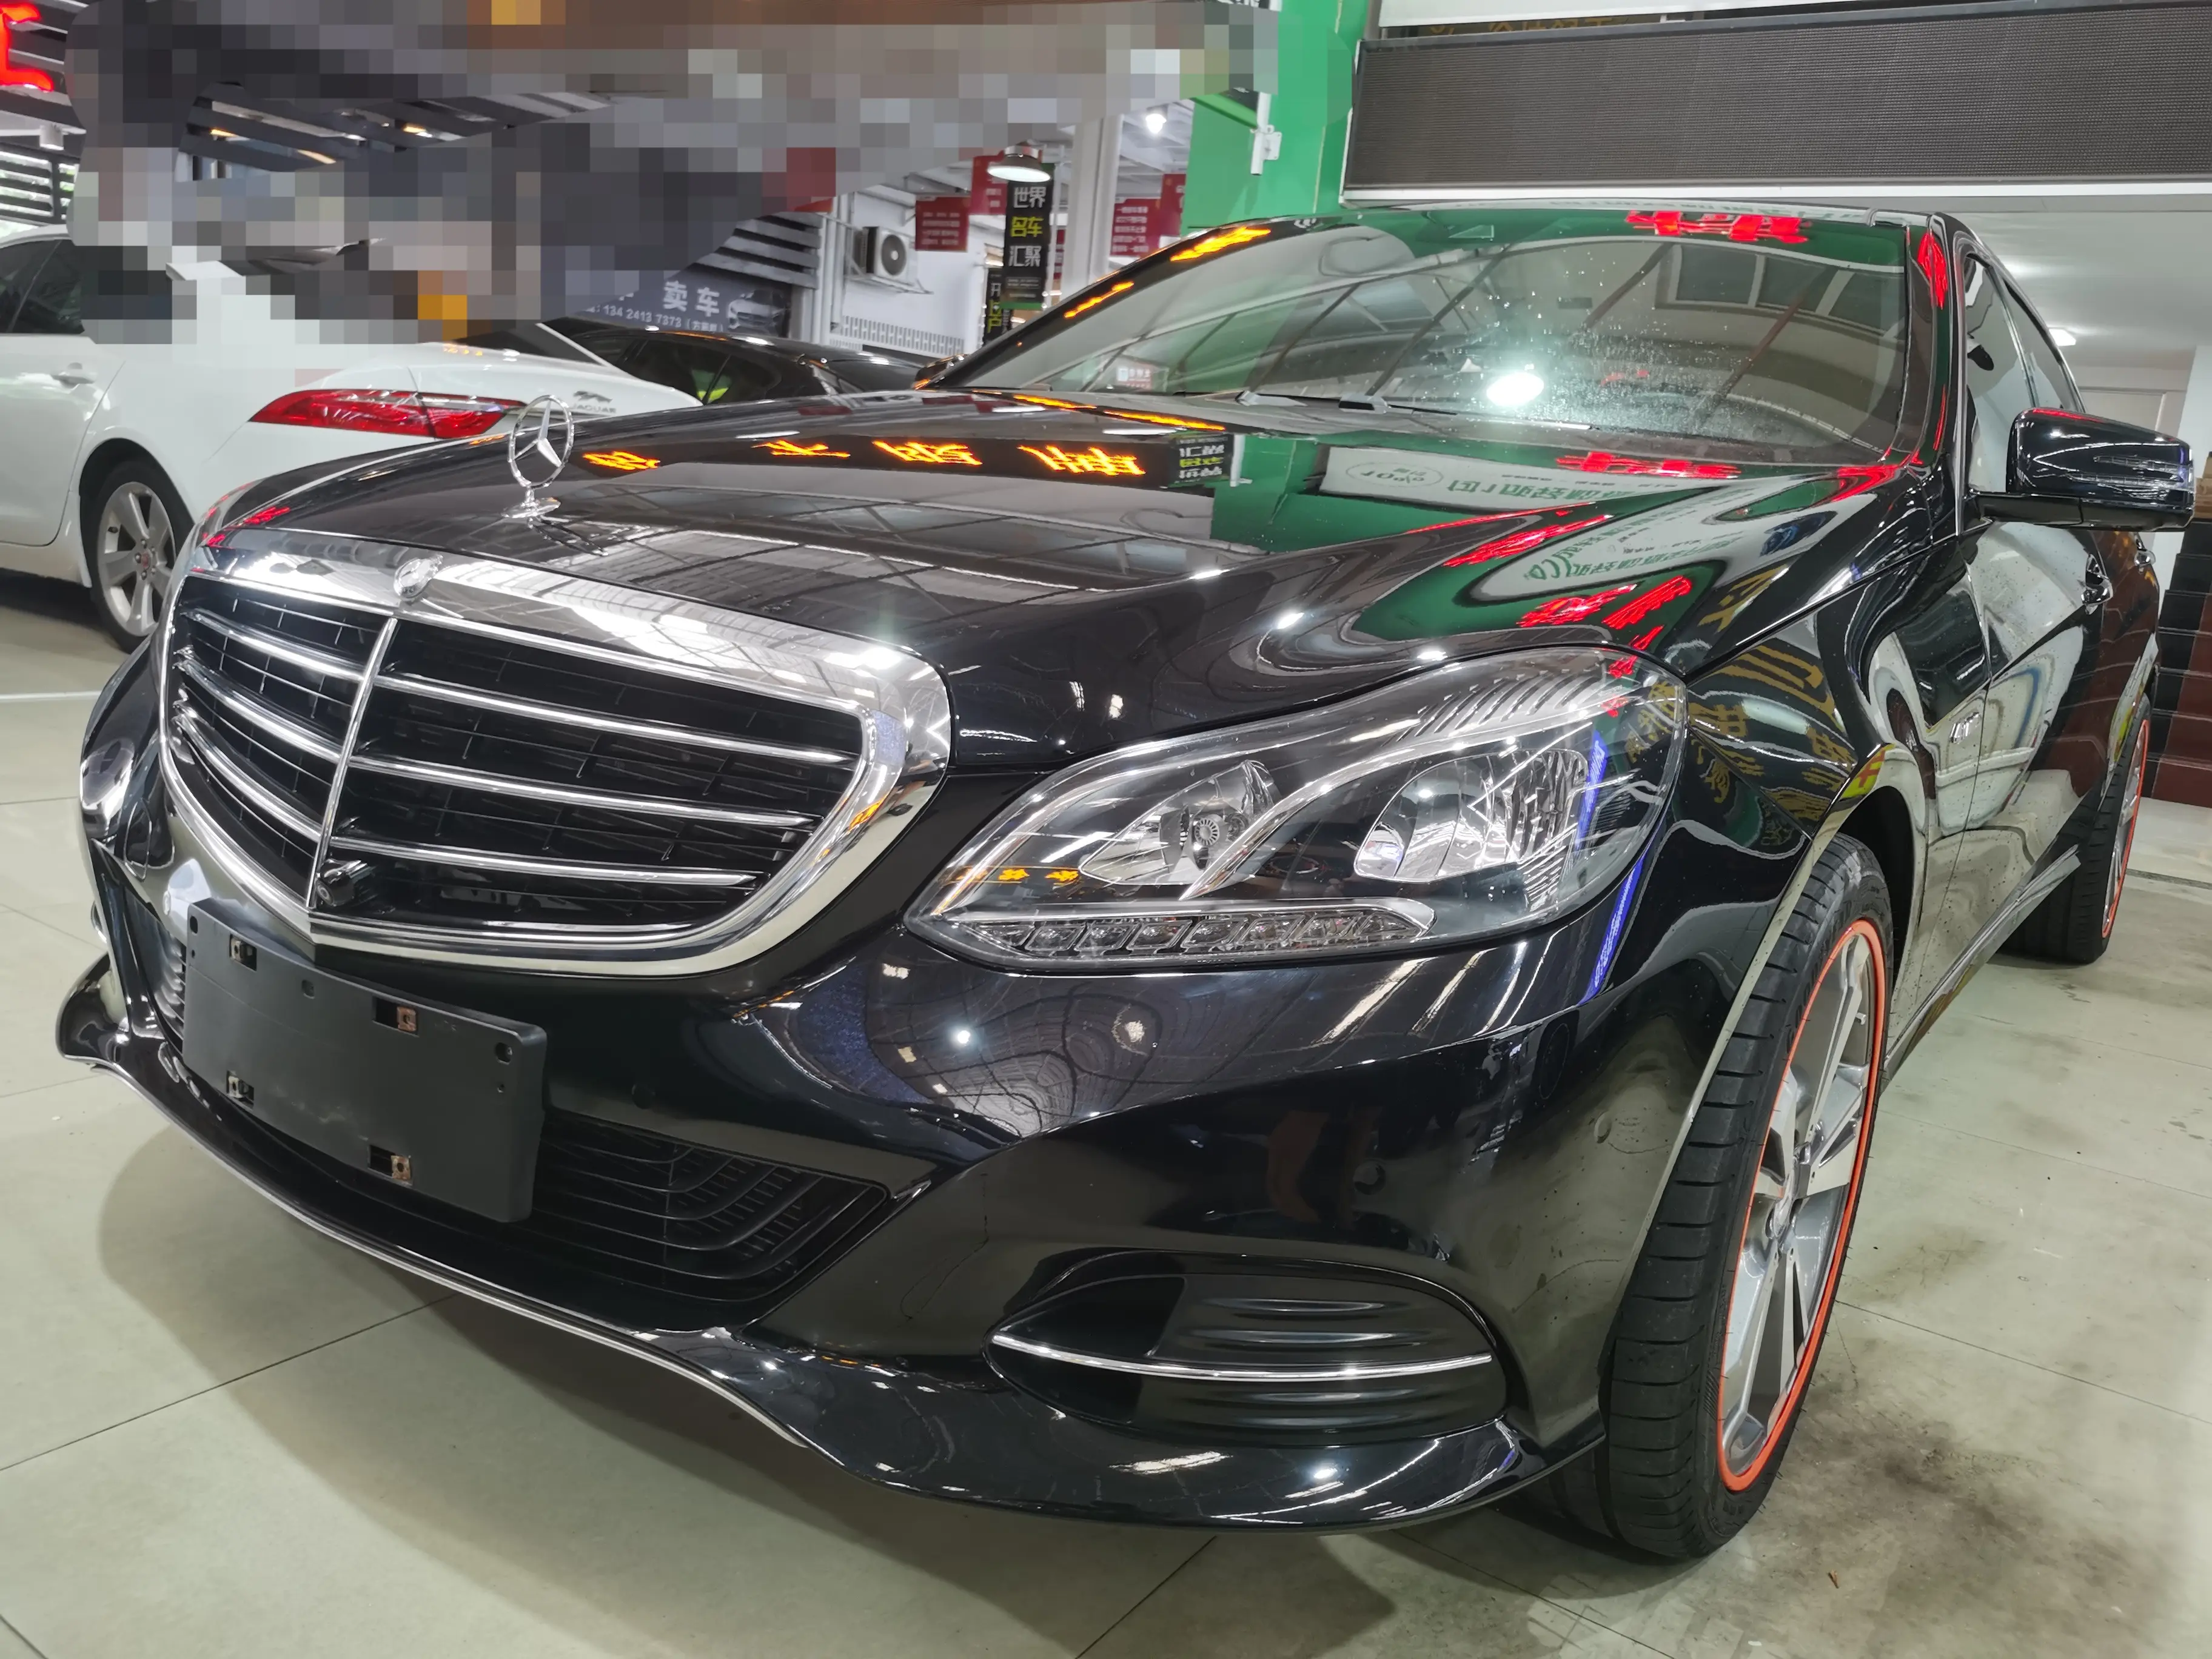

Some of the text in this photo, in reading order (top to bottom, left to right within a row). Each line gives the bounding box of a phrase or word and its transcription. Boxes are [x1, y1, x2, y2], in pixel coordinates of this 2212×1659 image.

[1013, 186, 1047, 208] 世界
[1011, 216, 1044, 238] 名车
[1008, 245, 1042, 267] 汇聚
[663, 280, 720, 317] 卖车
